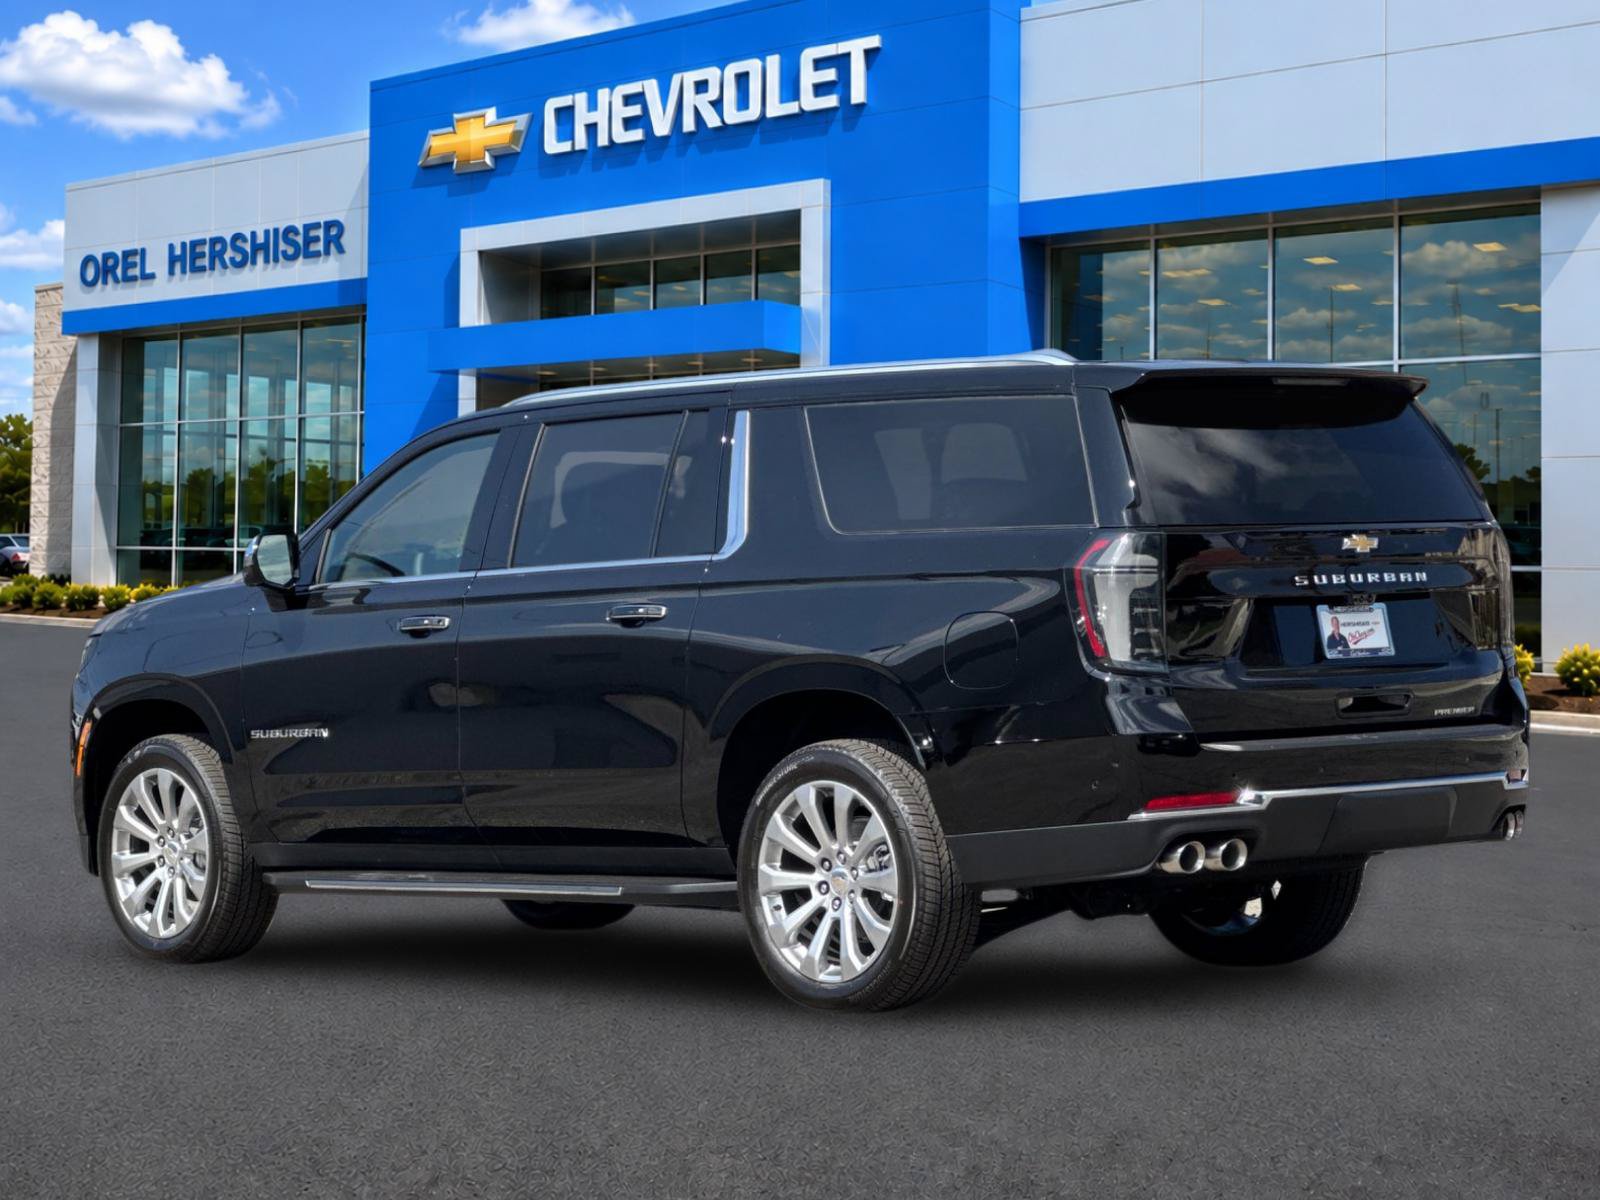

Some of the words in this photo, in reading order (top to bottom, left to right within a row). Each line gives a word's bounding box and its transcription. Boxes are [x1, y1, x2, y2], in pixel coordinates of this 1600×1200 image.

[543, 34, 882, 155] CHEVROLET
[79, 247, 156, 287] OREL
[167, 219, 345, 277] HERSHISER
[1294, 572, 1427, 586] SUBURBAN
[250, 728, 329, 739] SUBURBAN
